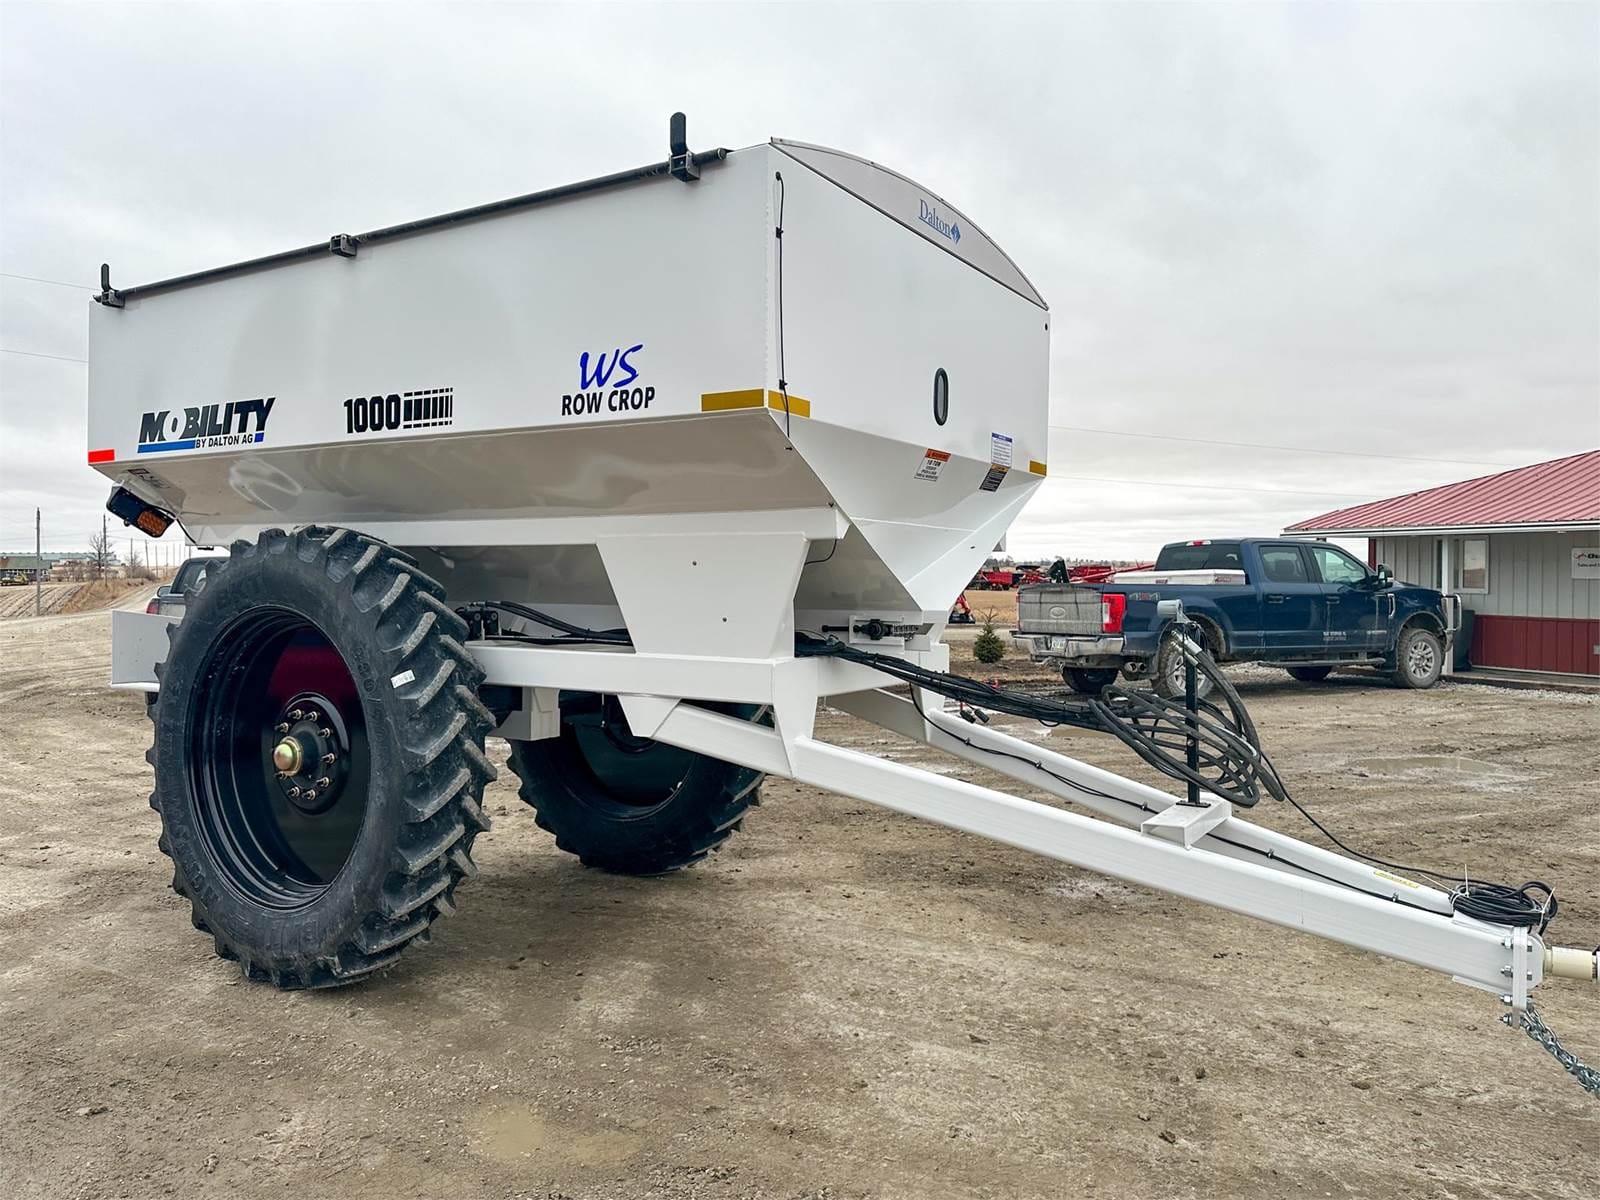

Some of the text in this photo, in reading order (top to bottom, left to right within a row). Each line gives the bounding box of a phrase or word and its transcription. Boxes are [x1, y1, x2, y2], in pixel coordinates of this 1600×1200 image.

[919, 198, 951, 237] Dalton
[579, 343, 644, 390] WS
[138, 397, 276, 444] MOBILITY
[343, 393, 401, 434] 1000
[561, 386, 656, 416] ROW CROP
[195, 433, 254, 449] BY DALTON AG
